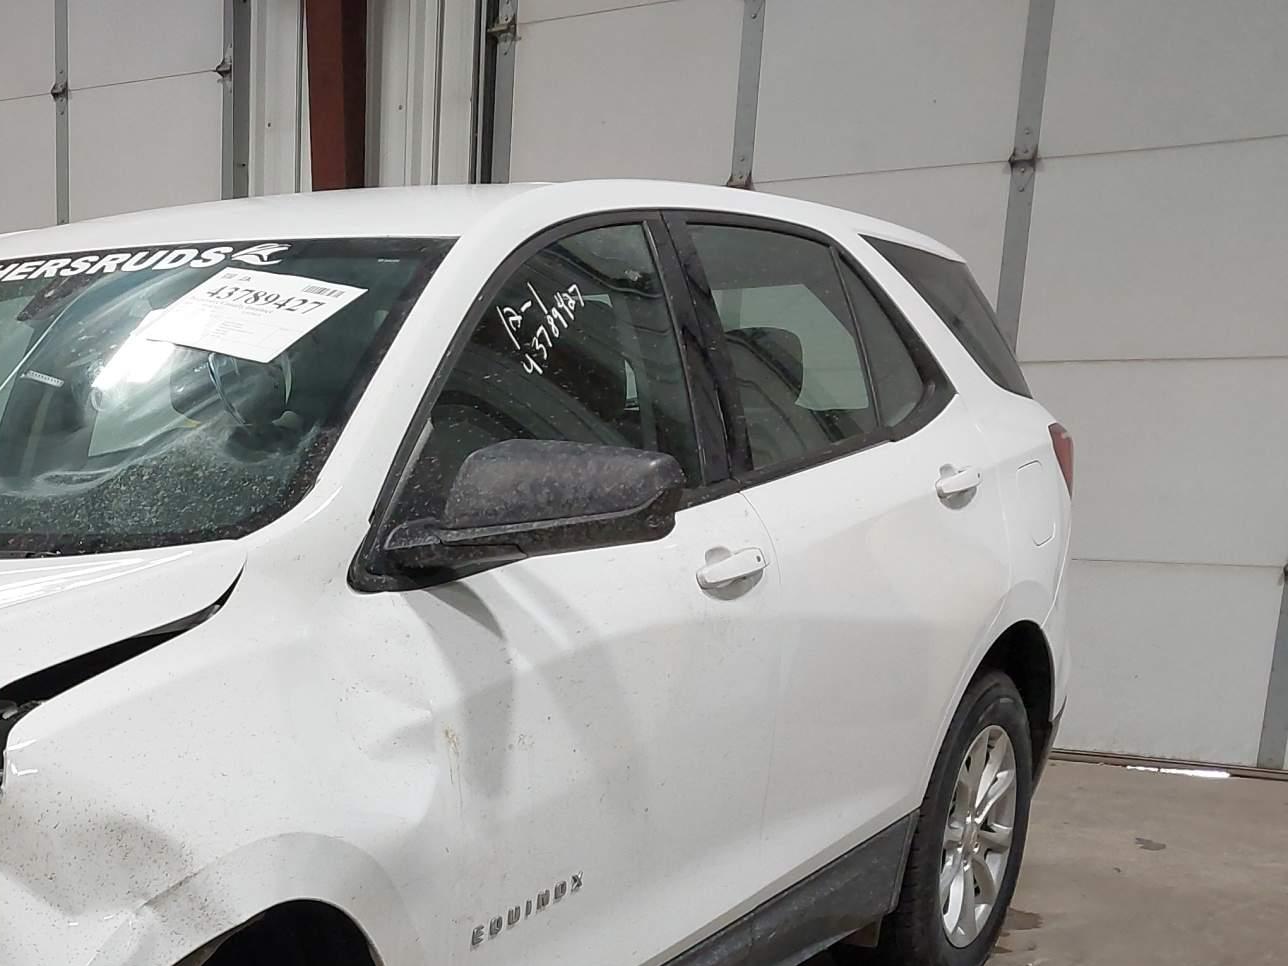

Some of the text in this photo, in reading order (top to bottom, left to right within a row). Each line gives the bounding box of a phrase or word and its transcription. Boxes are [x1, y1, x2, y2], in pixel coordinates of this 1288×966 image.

[206, 285, 326, 315] 43789427
[521, 284, 585, 375] 43789427
[471, 871, 583, 946] EQUINOX
